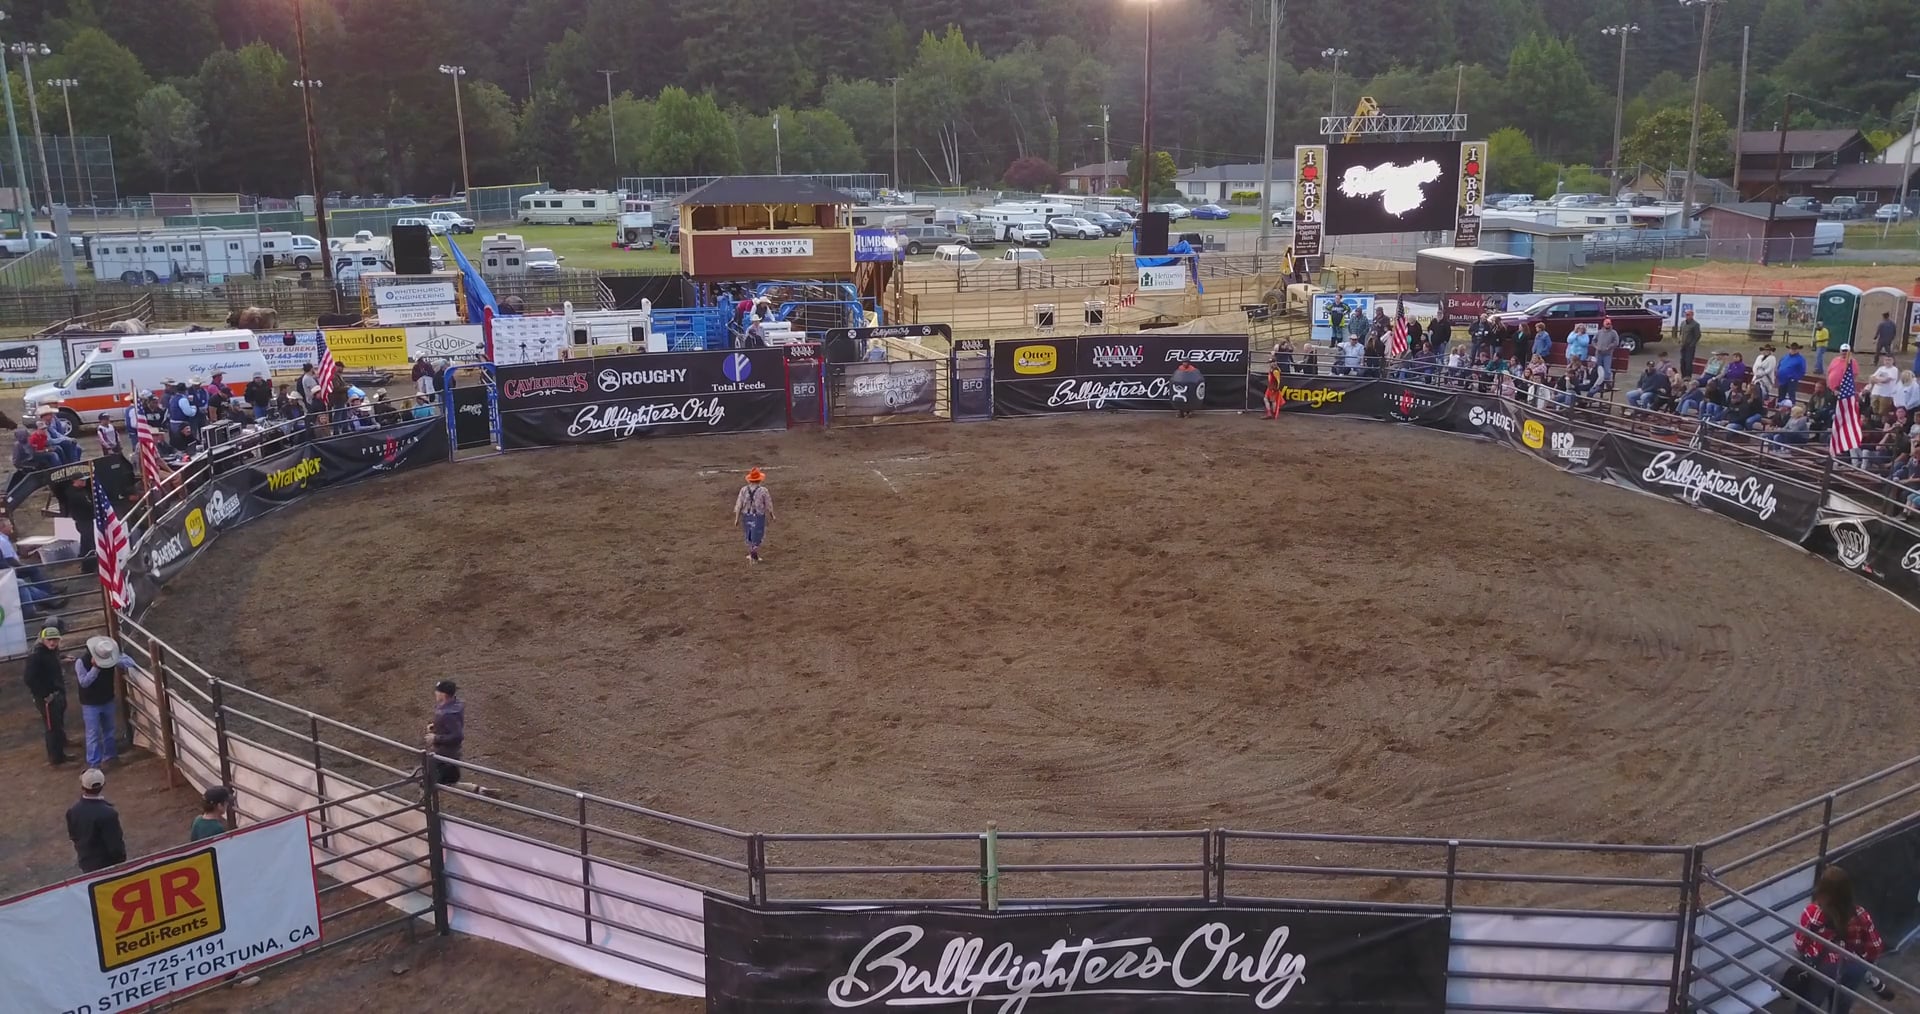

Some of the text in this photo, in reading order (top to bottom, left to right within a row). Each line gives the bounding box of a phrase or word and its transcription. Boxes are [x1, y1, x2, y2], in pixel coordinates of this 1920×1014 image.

[1306, 151, 1314, 165] I
[1470, 148, 1477, 160] I
[738, 247, 807, 255] ARENA
[329, 334, 369, 345] Edward
[370, 334, 403, 345] Jones
[425, 336, 465, 350] SEQUOIA
[338, 353, 398, 362] INVESTMENTS
[1022, 350, 1051, 359] Otter
[1165, 350, 1240, 362] FLEXFIT
[188, 361, 251, 373] City Ambulance
[622, 368, 687, 385] ROUGHY
[503, 372, 589, 400] CAVENDER'S
[711, 381, 766, 392] Total Feeds
[793, 385, 816, 395] BFO
[962, 381, 983, 390] BFO
[1047, 379, 1147, 409] Bullfighters
[567, 397, 725, 437] Bullfighters Only
[1486, 411, 1516, 432] HOOEY
[1551, 432, 1574, 449] BFO
[266, 457, 322, 492] Wrangler
[1642, 451, 1777, 520] Bullfighters Only
[98, 972, 179, 1011] STREET
[185, 937, 284, 982] FORTUNA,
[288, 925, 315, 943] CA
[107, 938, 225, 989] 707-725-1191
[828, 922, 1307, 1014] Bullfighters Only
